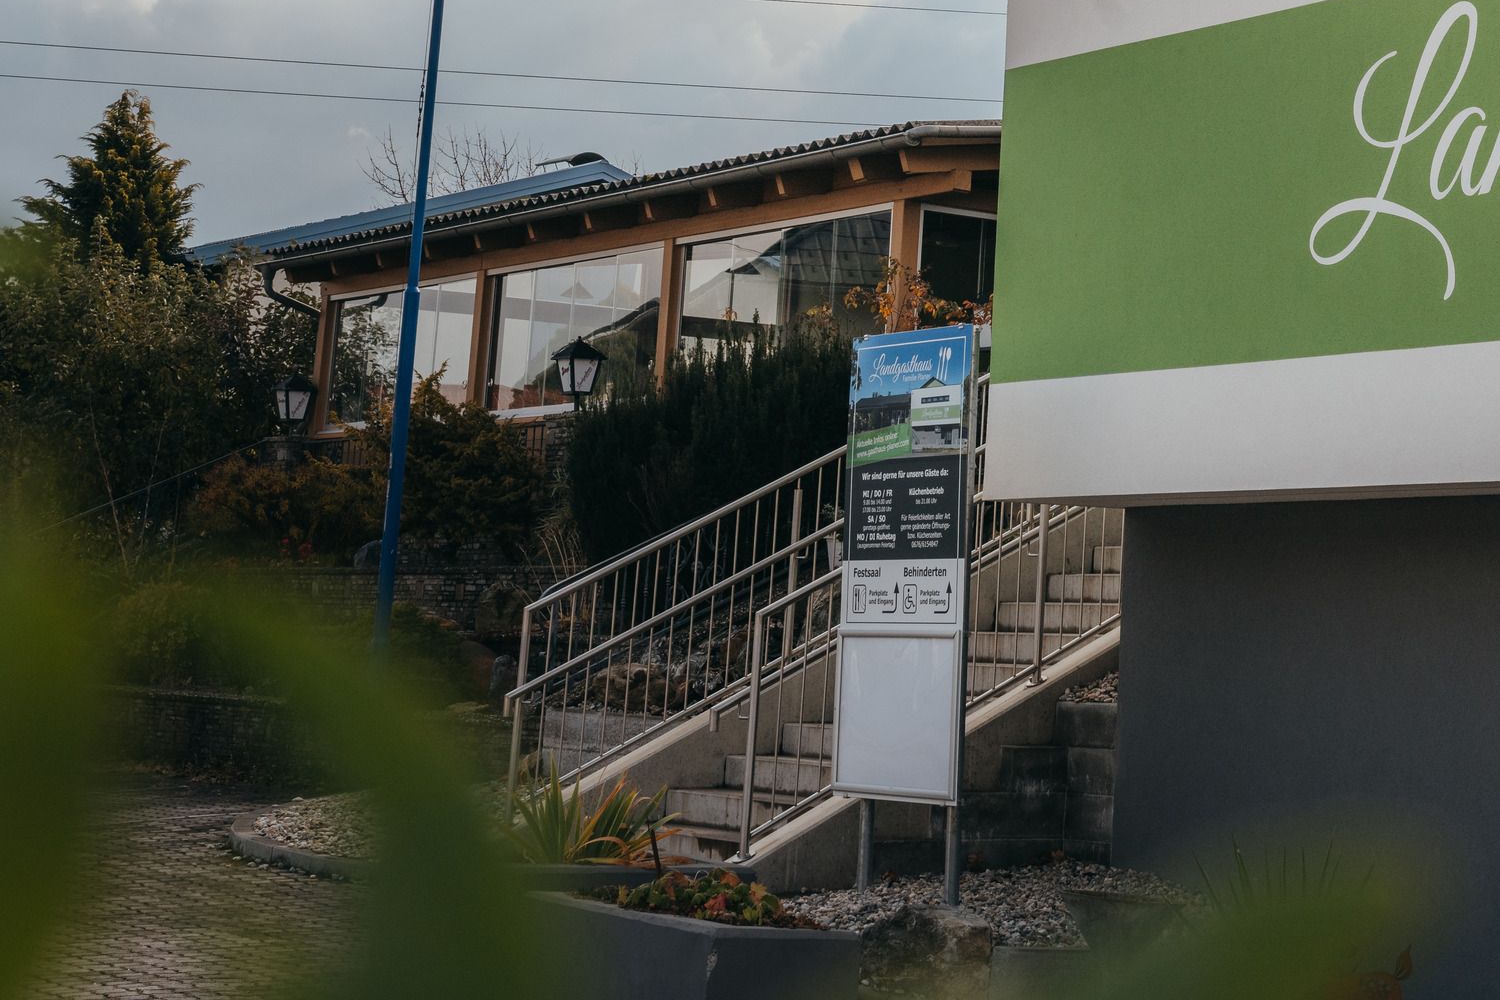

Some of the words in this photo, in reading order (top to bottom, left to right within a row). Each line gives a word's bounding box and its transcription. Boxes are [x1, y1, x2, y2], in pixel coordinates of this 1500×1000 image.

[868, 353, 933, 386] Landgasthaus
[873, 435, 884, 445] Infos
[884, 432, 898, 442] online
[862, 472, 871, 481] Wir
[871, 472, 883, 481] sind
[883, 472, 897, 482] gerne
[898, 470, 906, 479] für
[906, 470, 924, 478] unsere
[925, 468, 939, 477] Gäste
[940, 467, 949, 477] da:
[874, 489, 882, 498] DO
[886, 489, 893, 497] FR
[909, 486, 945, 496] Küchenbetrieb
[867, 515, 875, 523] SA
[879, 514, 886, 523] SO
[856, 533, 865, 541] MO
[869, 533, 875, 541] DI
[876, 532, 896, 542] Ruhetag
[853, 566, 881, 578] Festsaal
[903, 566, 947, 577] Behinderten
[868, 589, 888, 597] Parkplatz
[920, 589, 940, 597] Parkplatz
[877, 598, 894, 606] Eingang
[928, 598, 946, 606] Eingang
